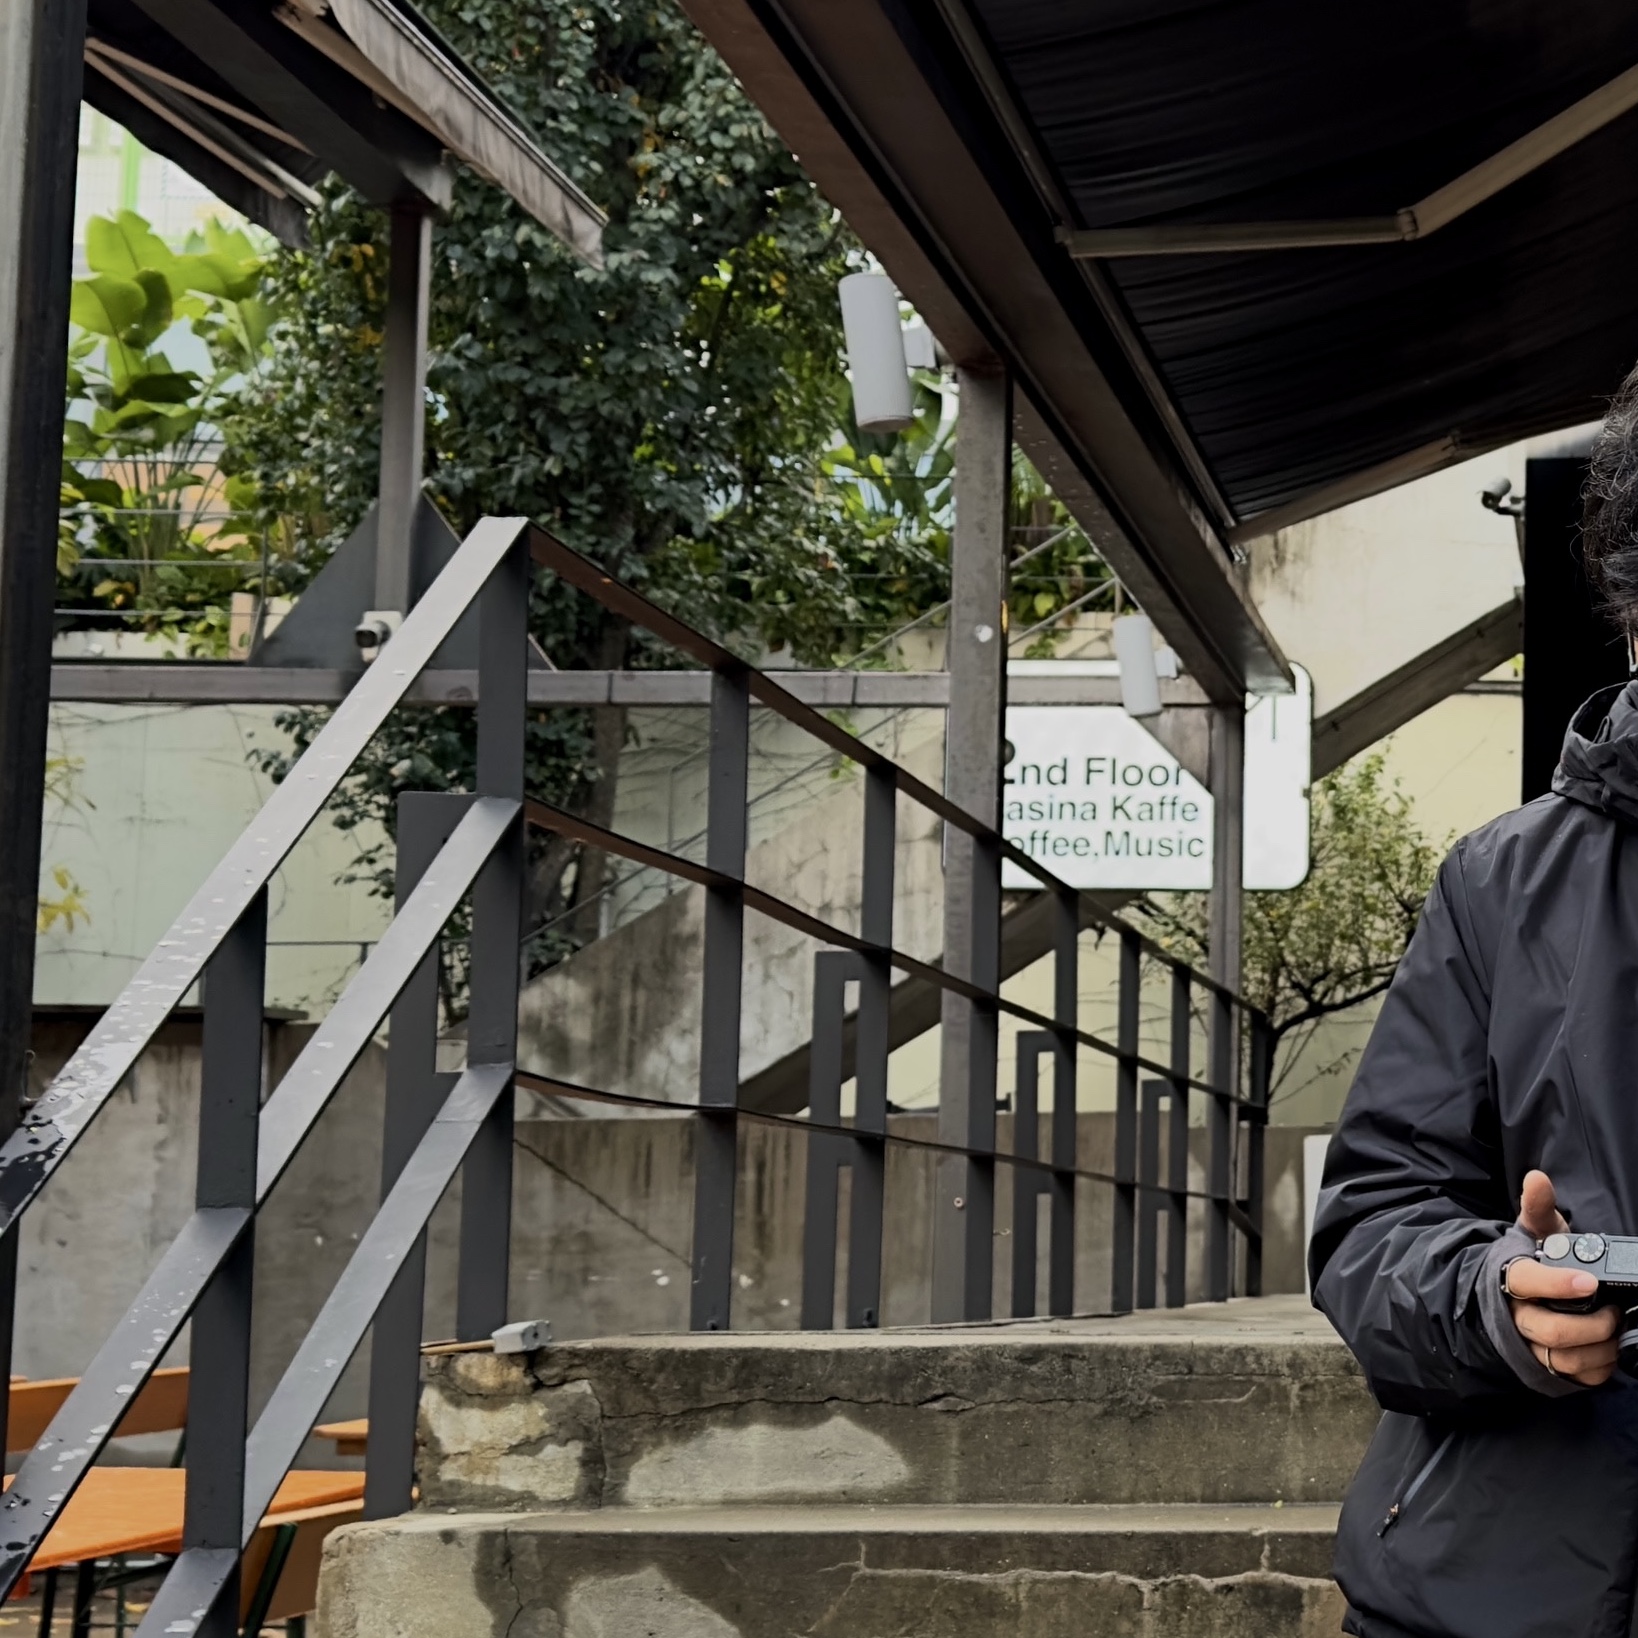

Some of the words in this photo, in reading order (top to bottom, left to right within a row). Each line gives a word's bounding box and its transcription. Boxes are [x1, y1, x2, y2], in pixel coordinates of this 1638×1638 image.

[1004, 757, 1068, 786] nd
[1006, 795, 1097, 822] asina
[1111, 795, 1199, 822] Kaffe
[1007, 830, 1205, 861] offee,Music
